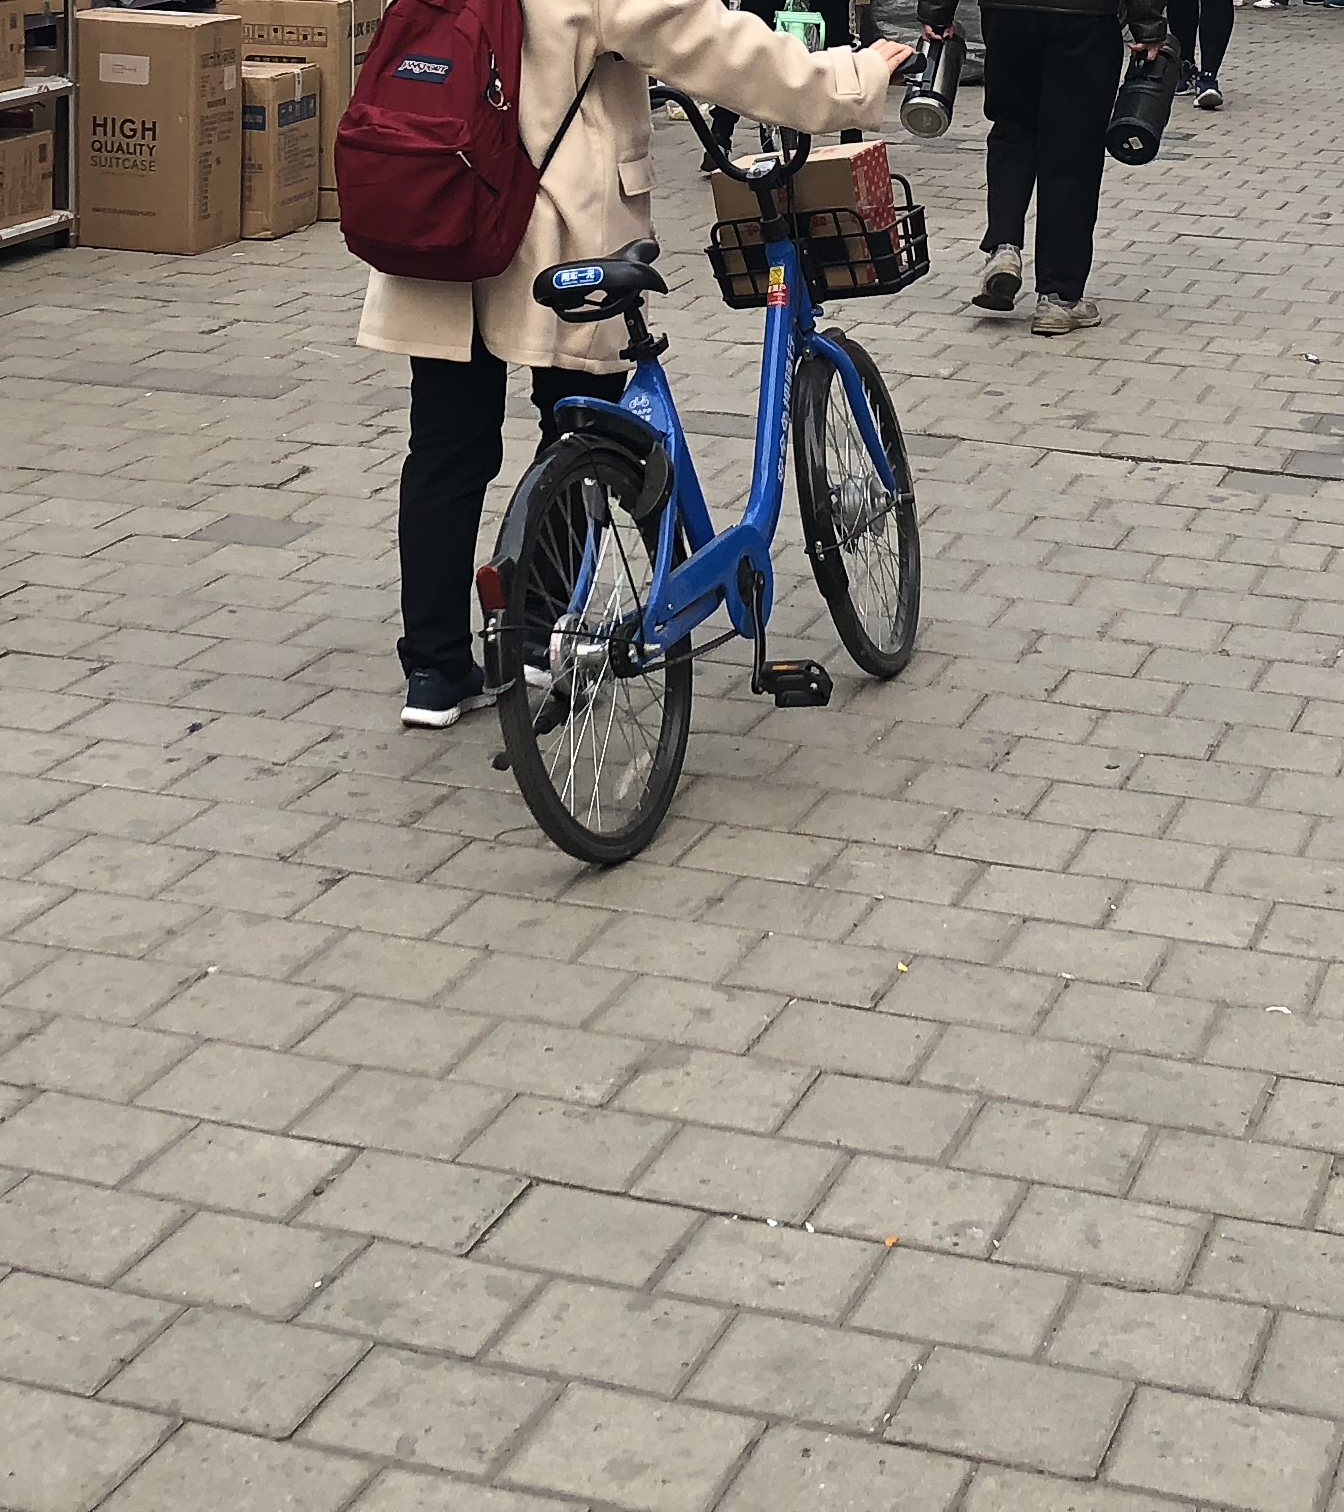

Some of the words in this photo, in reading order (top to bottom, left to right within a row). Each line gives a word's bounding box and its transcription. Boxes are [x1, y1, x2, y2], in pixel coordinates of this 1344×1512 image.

[92, 115, 157, 141] HIGH
[91, 139, 157, 157] QUALITY
[90, 155, 157, 172] SUITCASE
